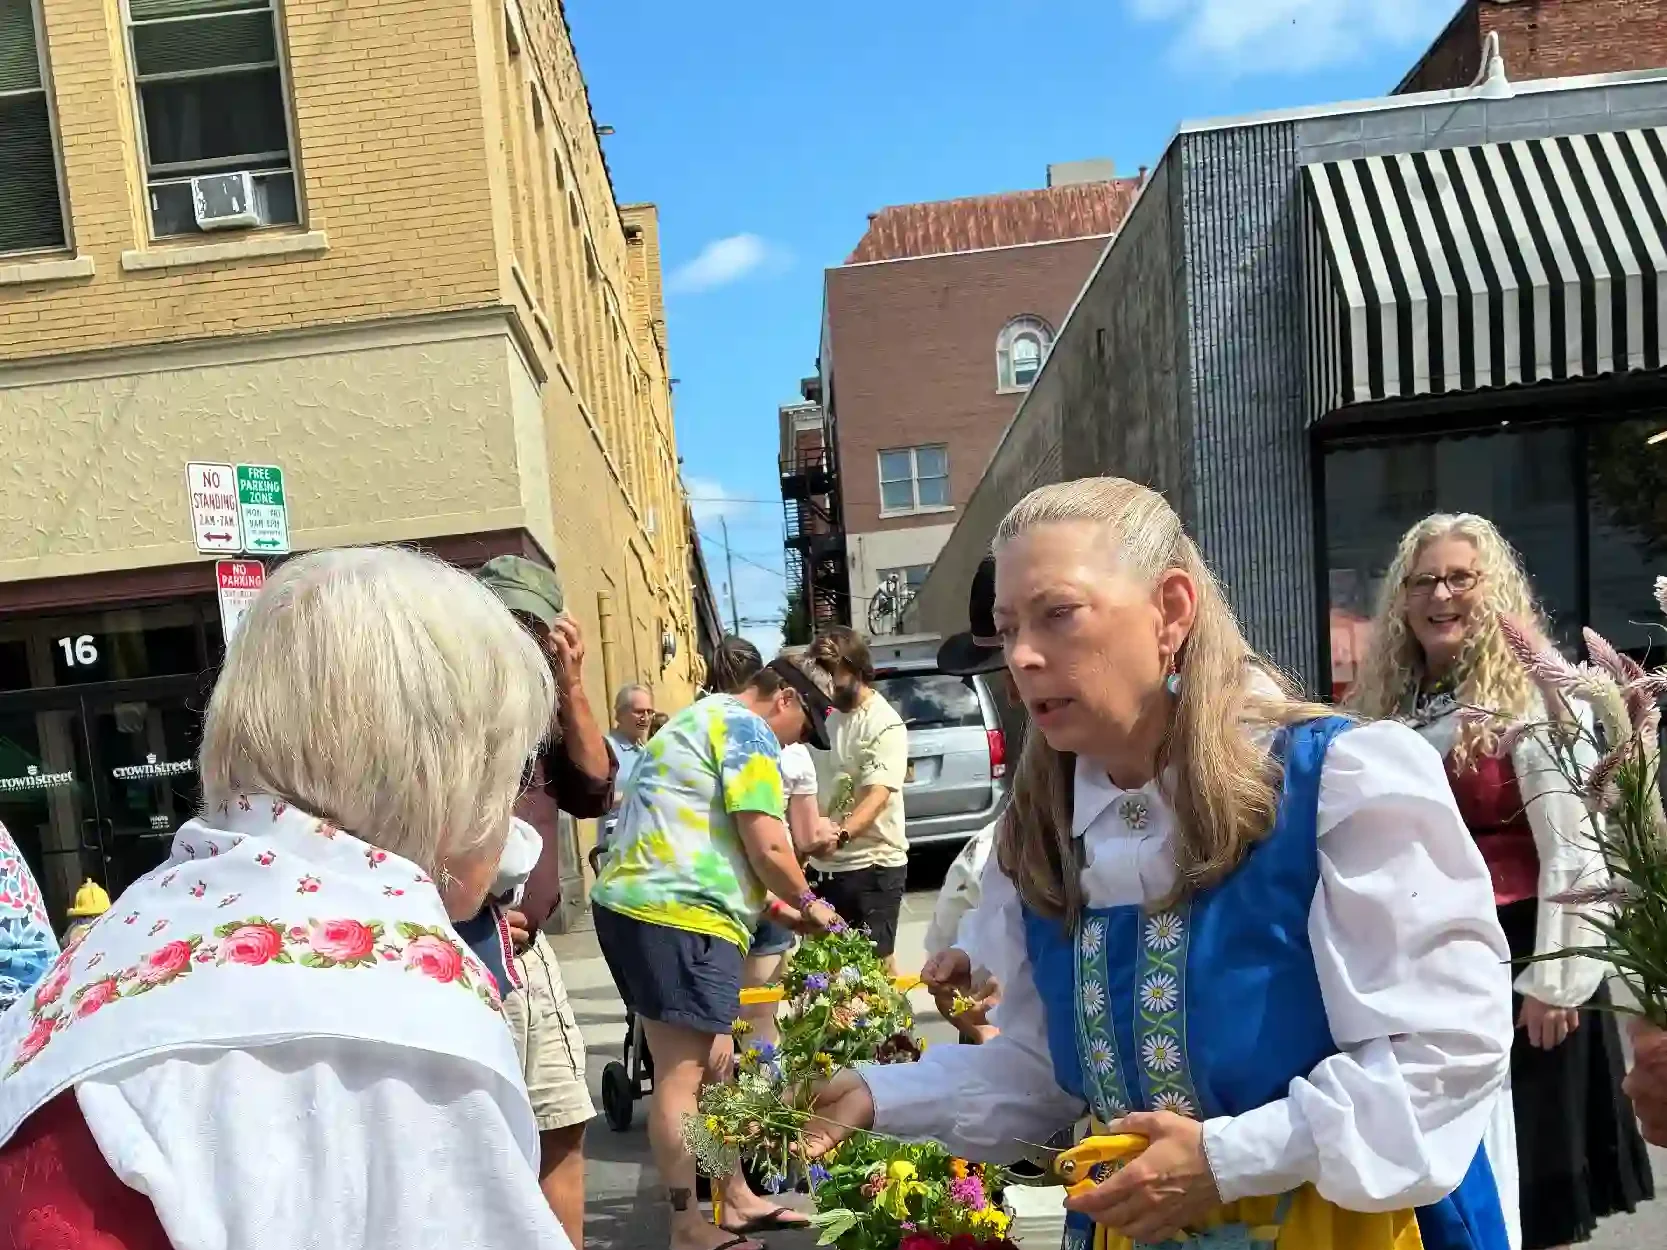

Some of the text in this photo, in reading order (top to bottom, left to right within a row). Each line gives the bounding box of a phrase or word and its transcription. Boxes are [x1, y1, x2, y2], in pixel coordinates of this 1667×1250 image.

[202, 471, 220, 489] NO
[248, 468, 271, 480] FREE
[240, 480, 280, 493] PARKING
[193, 492, 235, 511] STANDING
[249, 492, 275, 504] ZONE
[232, 563, 247, 576] NO
[221, 575, 262, 588] PARKING
[58, 634, 99, 667] 16
[0, 770, 73, 788] rownstreet
